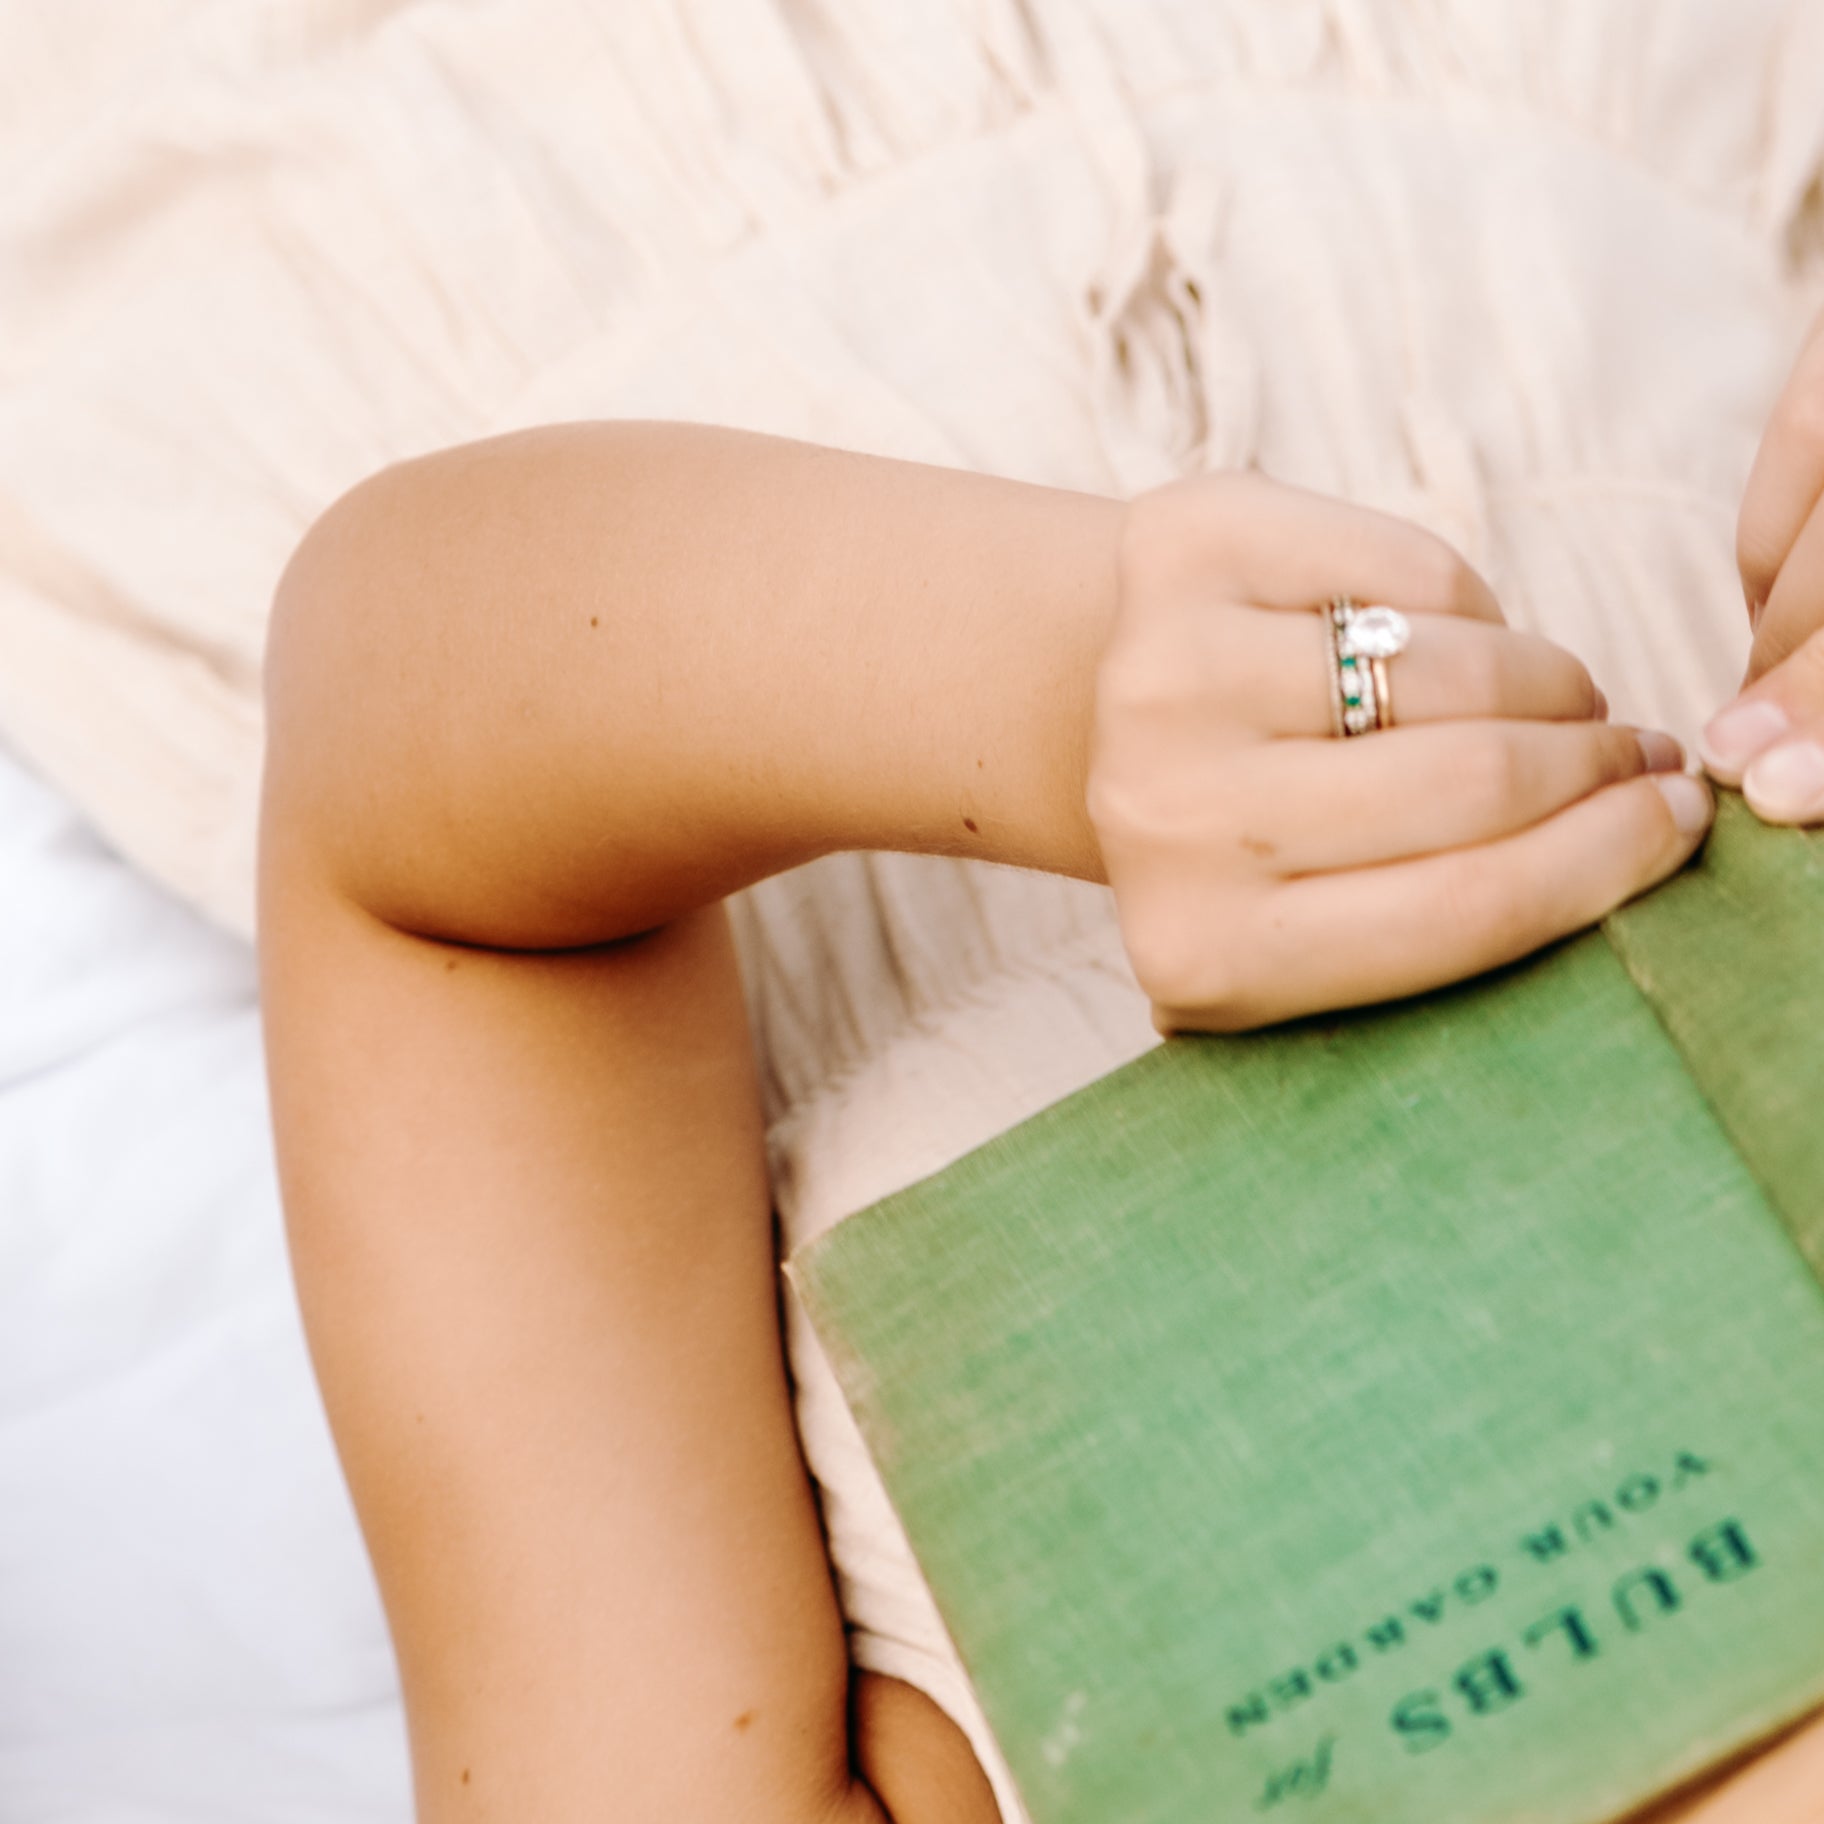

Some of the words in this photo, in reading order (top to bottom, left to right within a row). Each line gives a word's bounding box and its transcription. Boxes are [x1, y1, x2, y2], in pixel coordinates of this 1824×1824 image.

[1522, 1451, 1709, 1561] YOUR
[1224, 1566, 1498, 1737] GARDEN
[1388, 1519, 1759, 1753] BULBS
[1258, 1734, 1335, 1814] for
